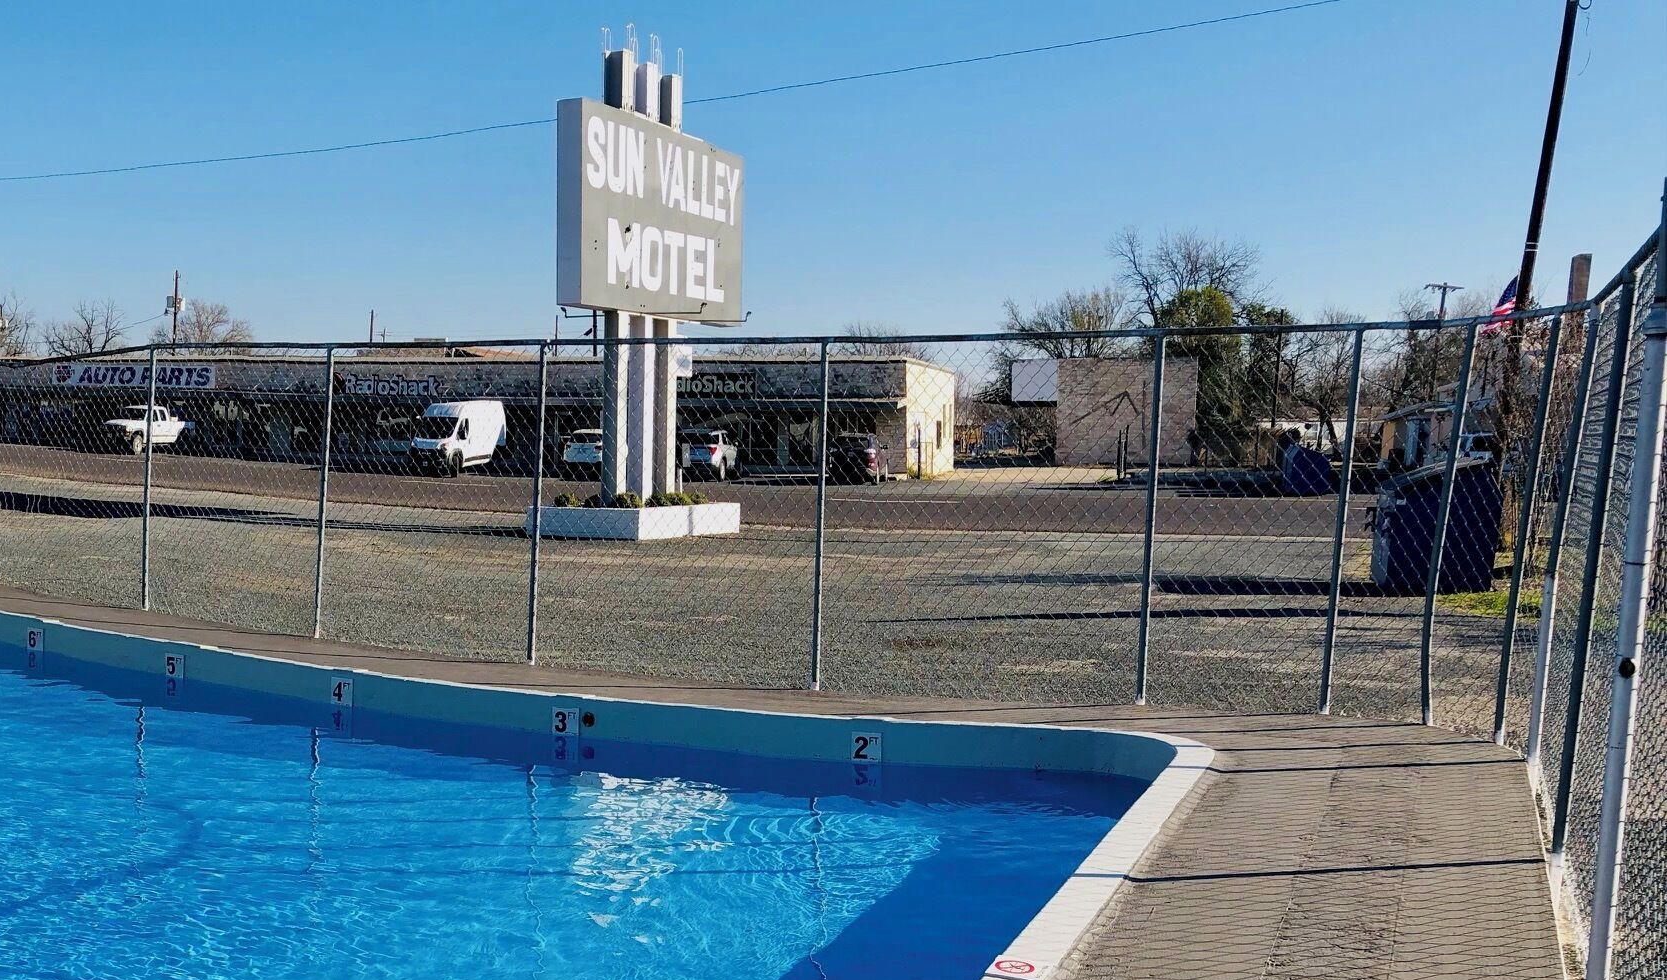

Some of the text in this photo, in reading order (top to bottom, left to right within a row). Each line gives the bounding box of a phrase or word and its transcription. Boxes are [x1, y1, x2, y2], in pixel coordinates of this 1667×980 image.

[586, 115, 741, 226] SUN VALLEY
[607, 217, 725, 304] MOTEL
[77, 366, 212, 387] AUTO PARTS
[345, 373, 439, 396] RadioShack
[676, 375, 755, 394] dioShack
[28, 630, 37, 648] 6
[166, 656, 176, 675] 5
[332, 681, 343, 702] 4
[555, 711, 577, 733] 3 FT
[854, 736, 869, 760] 2
